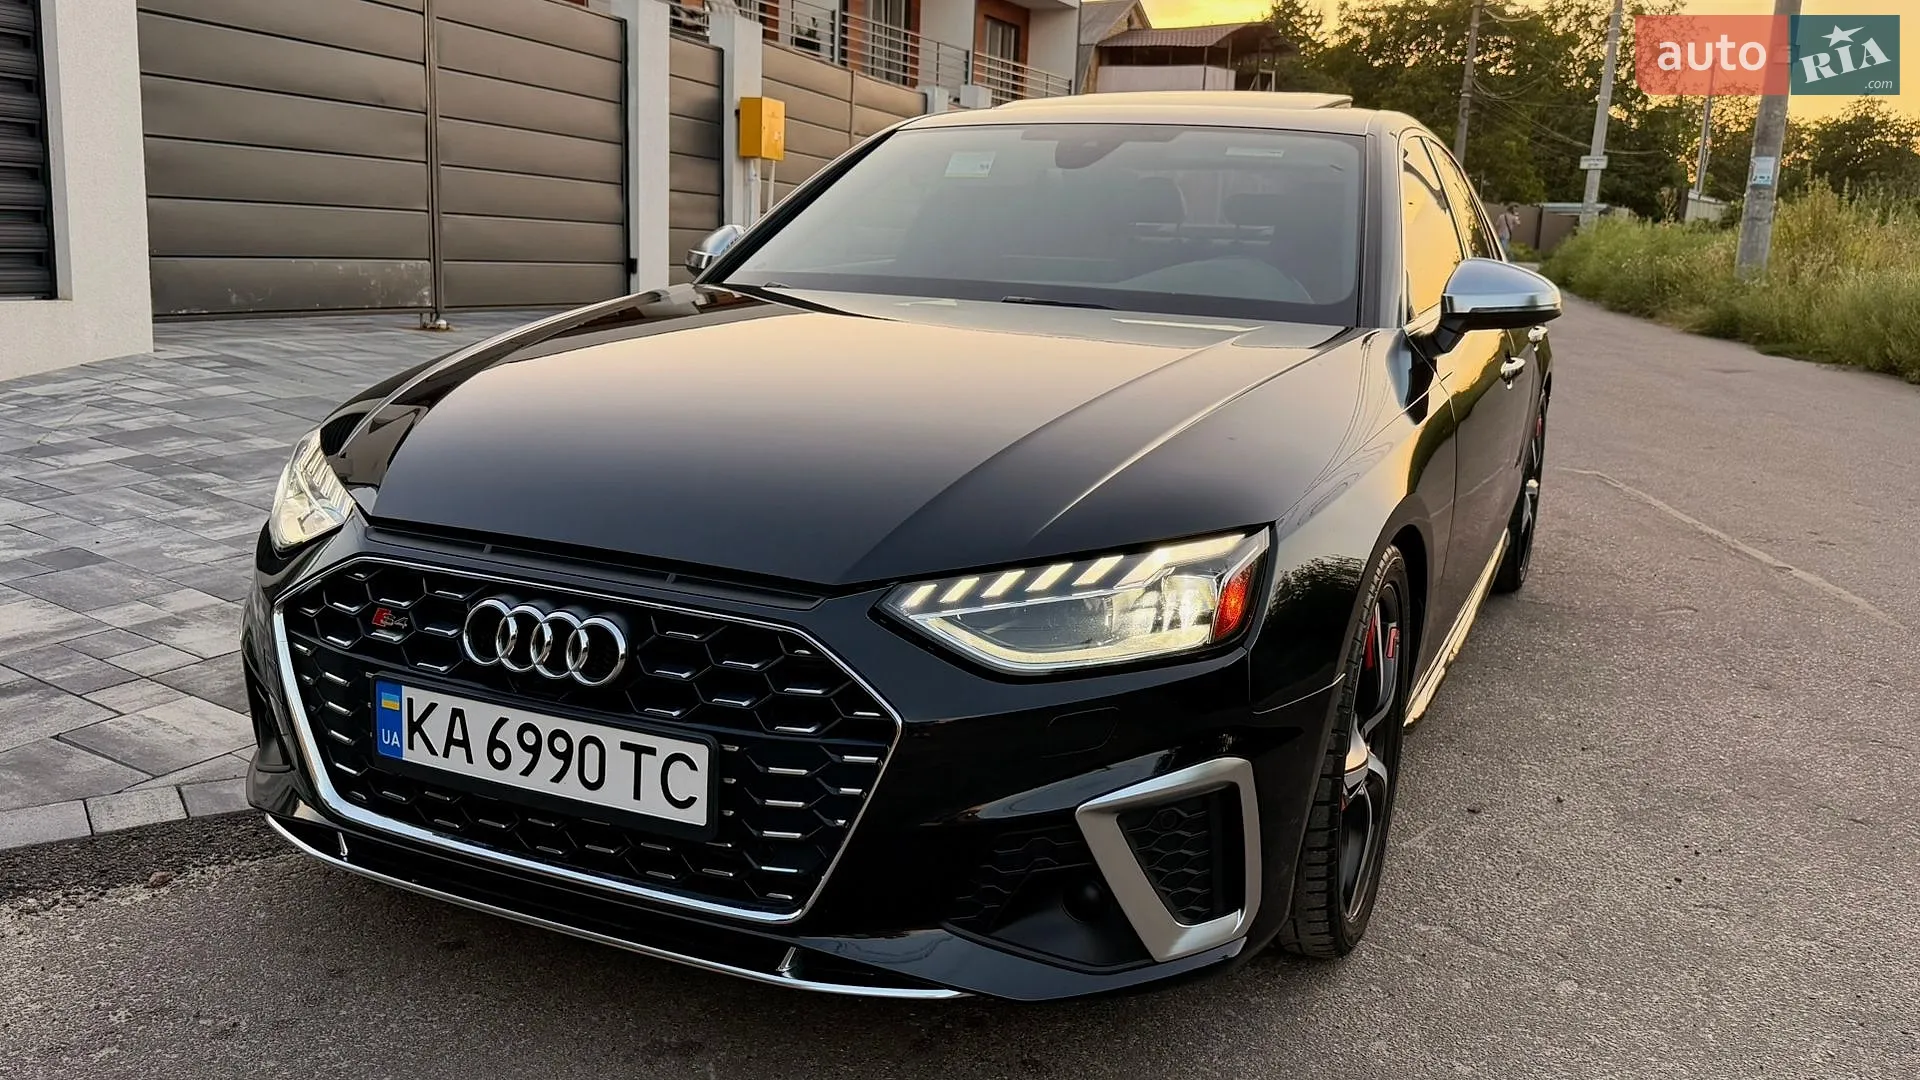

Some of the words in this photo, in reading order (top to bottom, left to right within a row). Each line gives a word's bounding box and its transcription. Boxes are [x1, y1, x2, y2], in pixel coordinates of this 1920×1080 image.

[382, 728, 400, 748] UA
[406, 697, 474, 765] KA
[486, 717, 607, 791] 6990
[620, 741, 699, 810] TC
